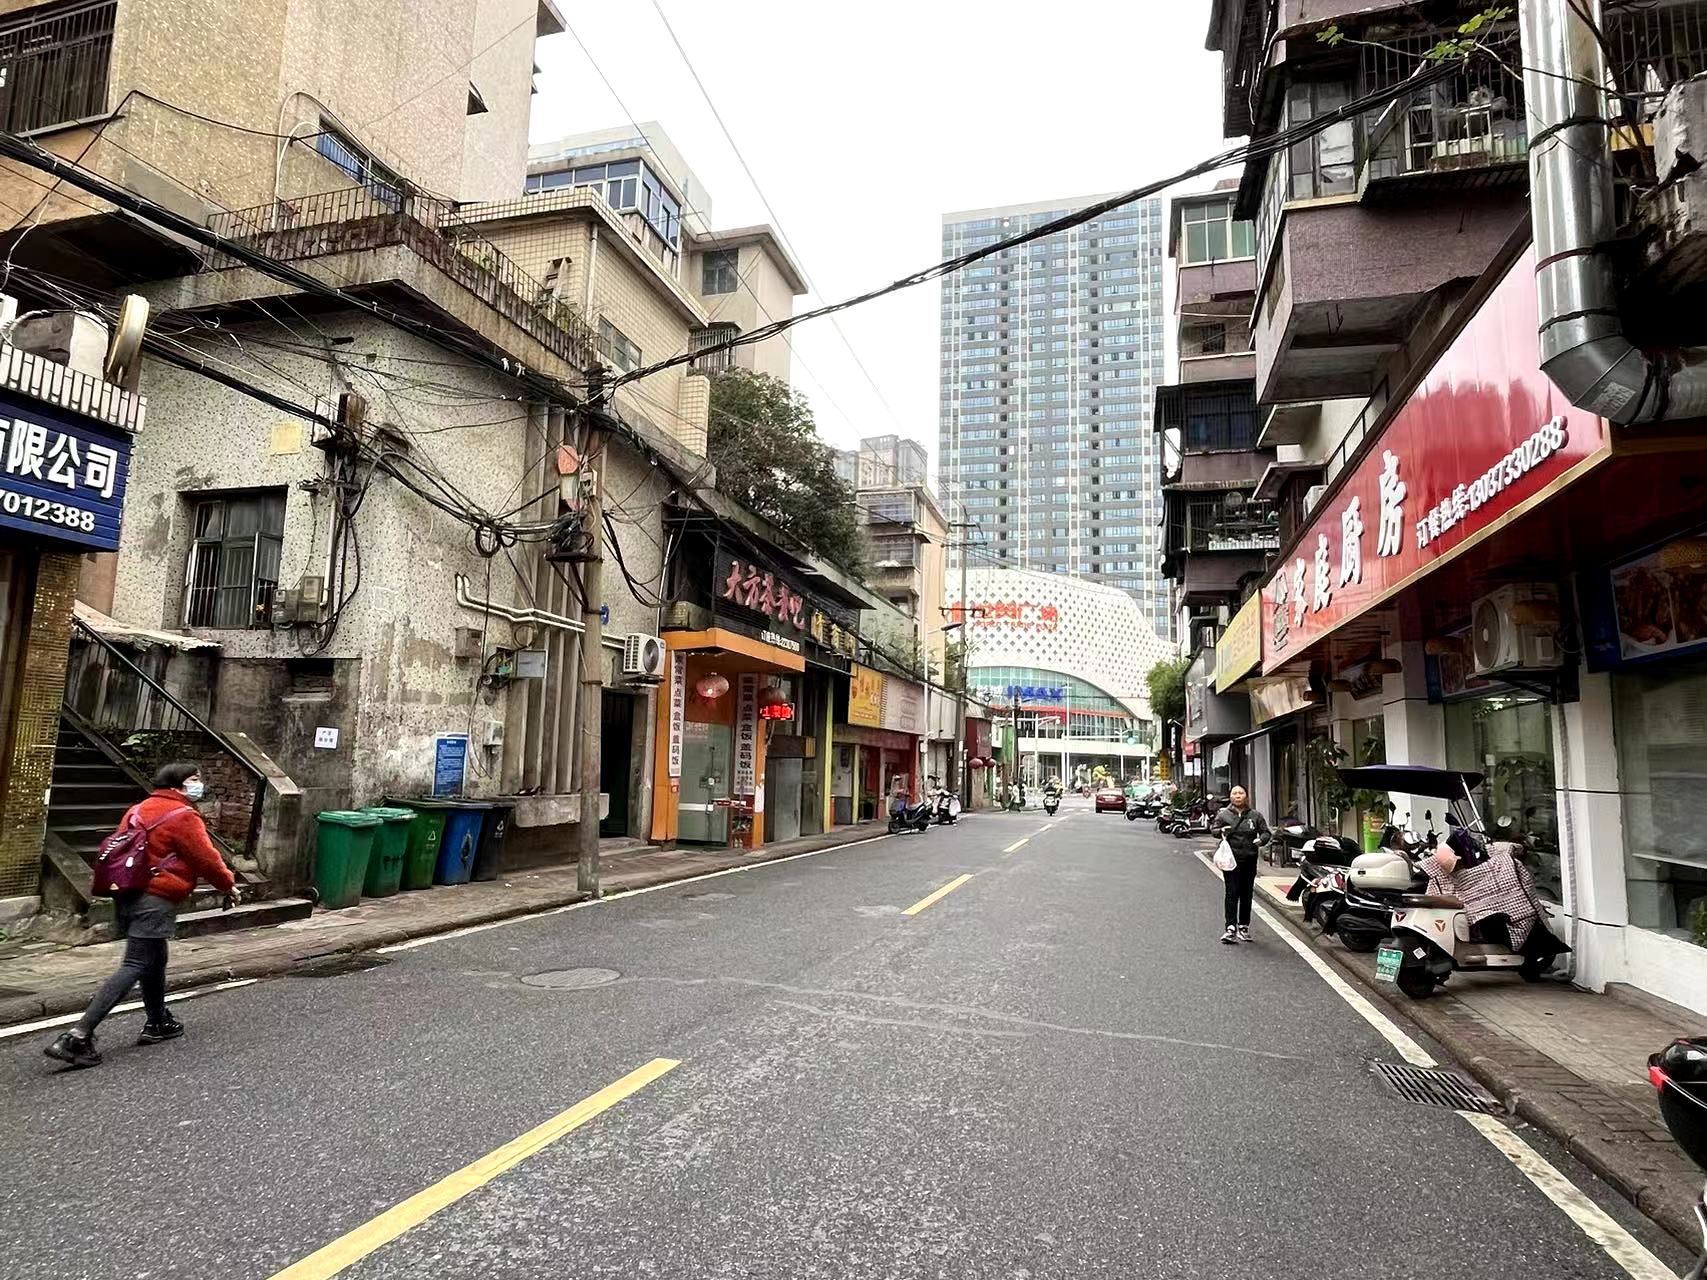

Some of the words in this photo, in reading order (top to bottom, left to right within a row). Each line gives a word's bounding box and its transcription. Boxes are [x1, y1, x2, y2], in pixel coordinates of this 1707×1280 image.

[0, 489, 95, 532] 012388
[1293, 449, 1408, 628] 家庭厨房
